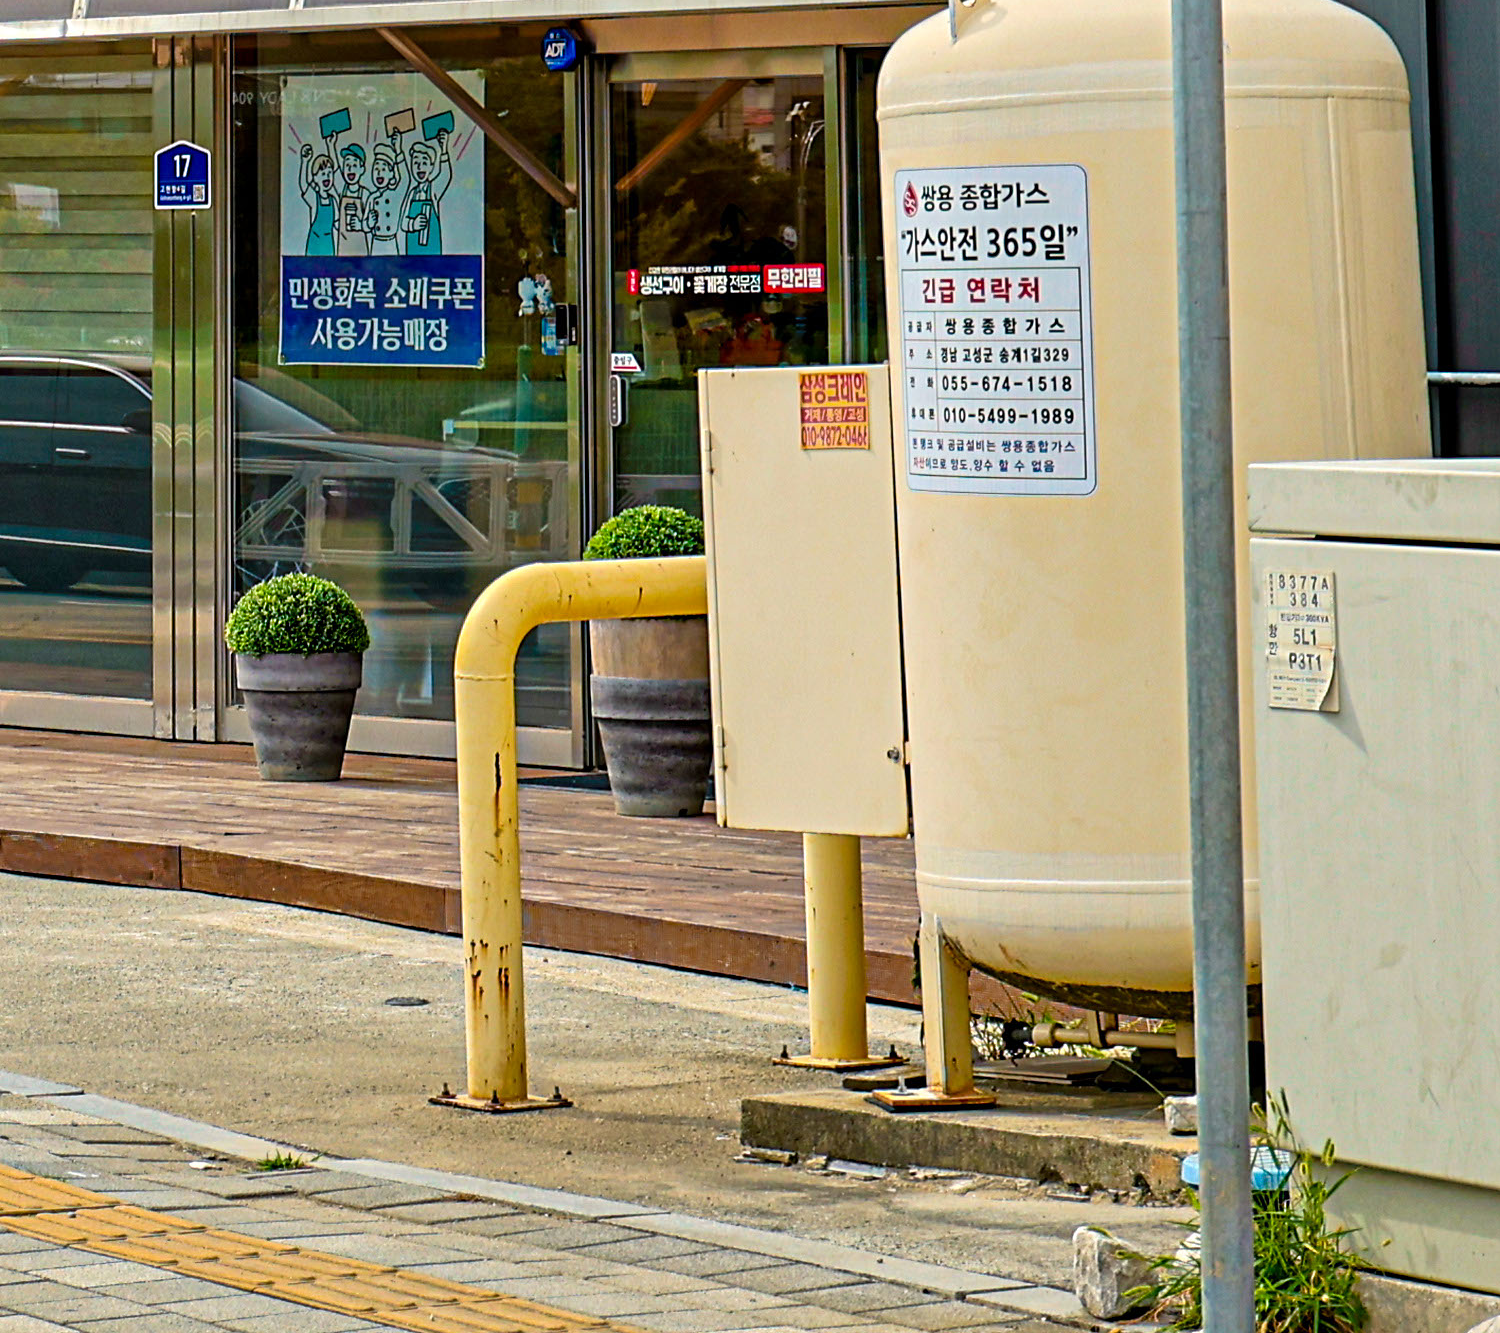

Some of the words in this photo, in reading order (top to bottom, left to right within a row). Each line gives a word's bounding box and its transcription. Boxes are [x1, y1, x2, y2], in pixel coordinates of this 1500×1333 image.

[545, 42, 566, 58] ADT
[173, 154, 192, 178] 17
[921, 184, 954, 212] 쌍용
[959, 182, 1050, 211] 종합가스
[767, 266, 822, 289] 무한리필
[289, 276, 377, 310] 민생회복
[384, 276, 476, 310] 소비쿠폰
[922, 277, 956, 304] 긴급
[967, 276, 1041, 304] 연락처
[310, 317, 449, 352] 사용가능매장
[940, 347, 958, 363] 경남
[962, 347, 994, 364] 고성군
[800, 373, 866, 404] 삼성크레인
[941, 375, 1073, 392] 055-674-1518
[943, 408, 1075, 425] 010-5499-1989
[1289, 592, 1319, 608] 384
[1293, 627, 1318, 646] 5L1
[1288, 652, 1322, 672] P3T1
